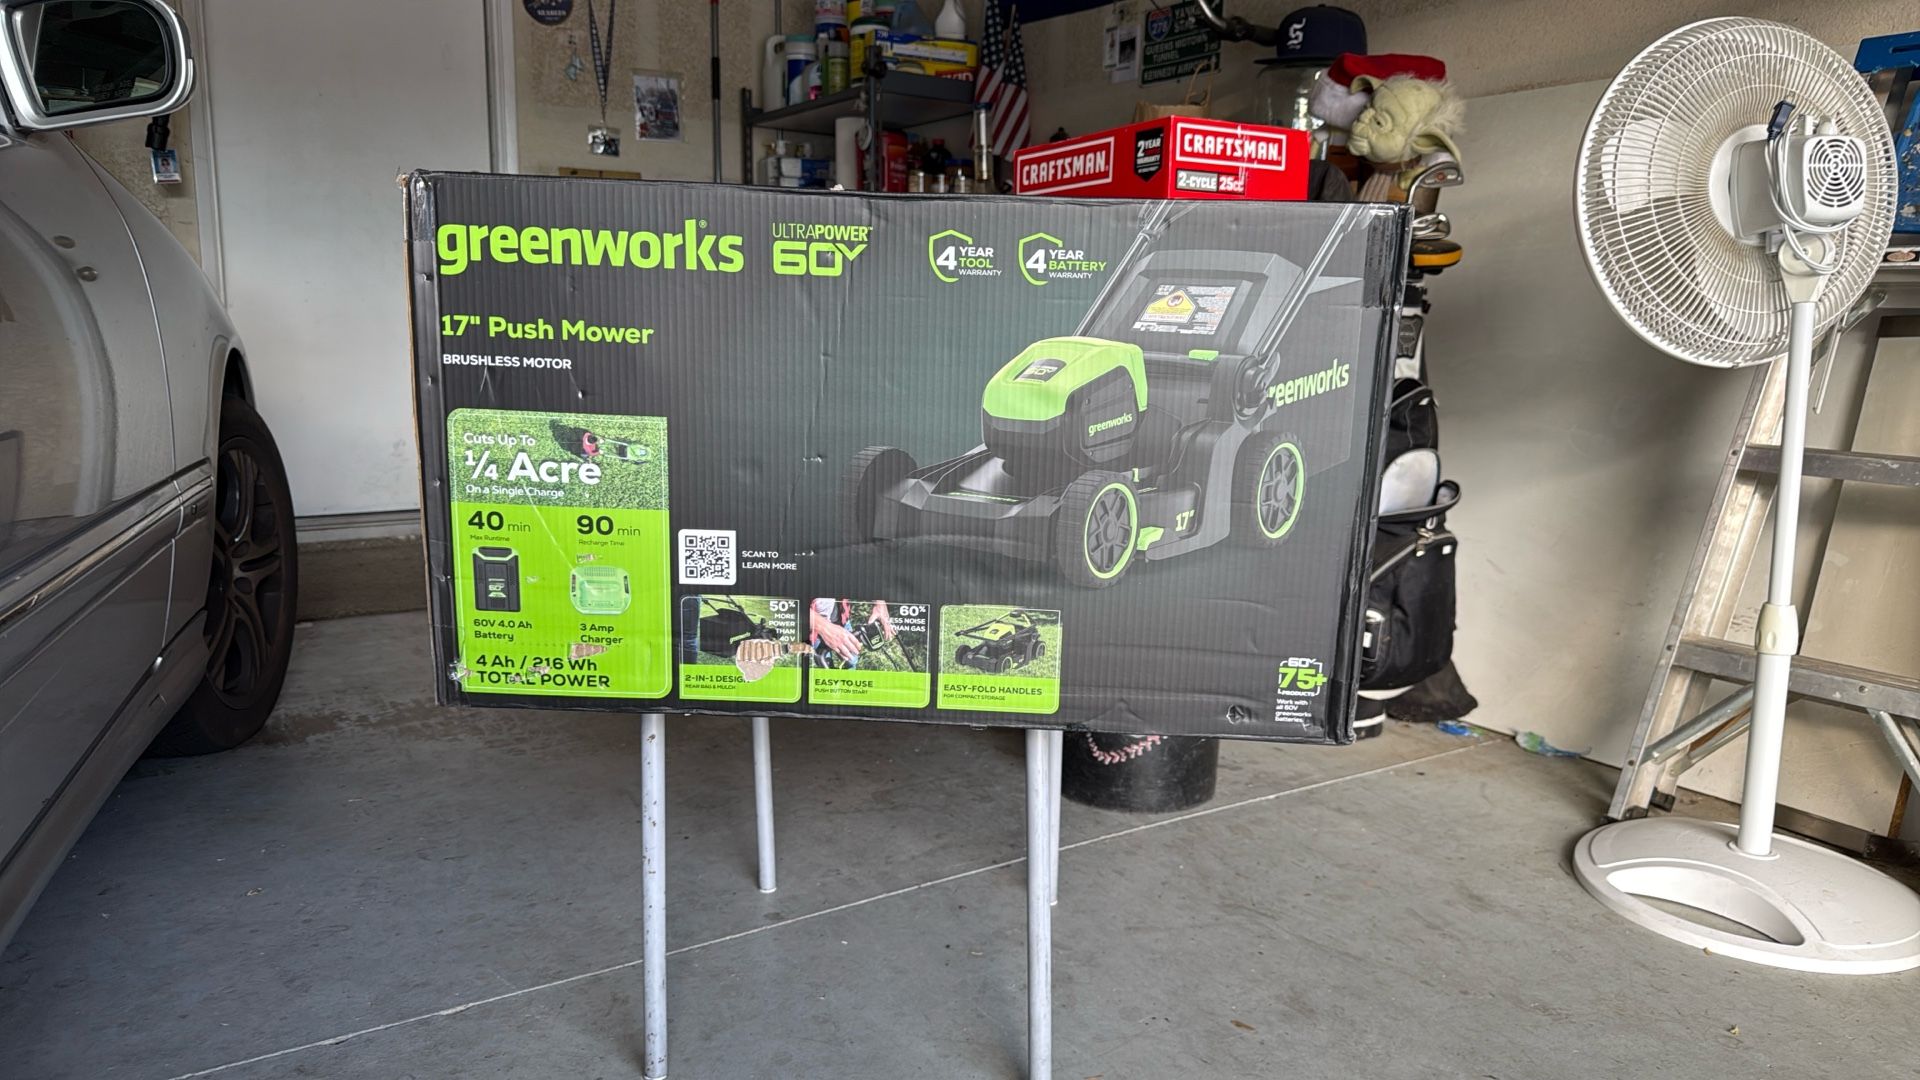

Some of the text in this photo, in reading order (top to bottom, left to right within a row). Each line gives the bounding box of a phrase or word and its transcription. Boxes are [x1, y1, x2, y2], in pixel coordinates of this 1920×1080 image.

[1137, 137, 1161, 158] 2 YEAR
[1184, 133, 1279, 161] CRAFTSMAN
[1022, 150, 1106, 186] CRAFTSMAN
[1178, 170, 1217, 188] 2-CYCLE
[437, 219, 744, 276] greenworks
[936, 246, 994, 270] 4 YEAR
[959, 258, 993, 268] TOOL
[1025, 249, 1084, 274] 4 YEAR
[1049, 261, 1107, 271] BATTERY
[1048, 271, 1093, 279] WARRANTY
[441, 315, 654, 345] 17" Push Mower
[443, 353, 572, 370] BRUSHLESS MOTOR
[1266, 358, 1350, 407] reenworks
[1088, 412, 1133, 437] greenworks
[464, 432, 536, 447] Cuts Up To
[507, 452, 602, 485] Acre
[466, 484, 482, 494] On
[491, 485, 524, 497] Single
[526, 487, 565, 499] Charge
[468, 510, 531, 532] 40 min
[576, 514, 641, 537] 90 min
[578, 539, 608, 547] Recharge
[741, 550, 765, 558] SCAN
[769, 600, 796, 612] 50%
[899, 605, 926, 616] 60%
[473, 619, 533, 629] 60V 4.0 Ah
[580, 623, 614, 633] 3 Amp
[474, 631, 514, 642] Battery
[580, 634, 623, 645] Charger
[476, 655, 597, 671] 4 Ah / 216 Wh
[540, 673, 610, 688] POWER
[685, 674, 750, 683] 2-IN-1 DESIG
[814, 679, 873, 688] EASY TO USE
[1278, 667, 1328, 690] 75+
[943, 684, 1043, 696] EASY-FOLD HANDLES
